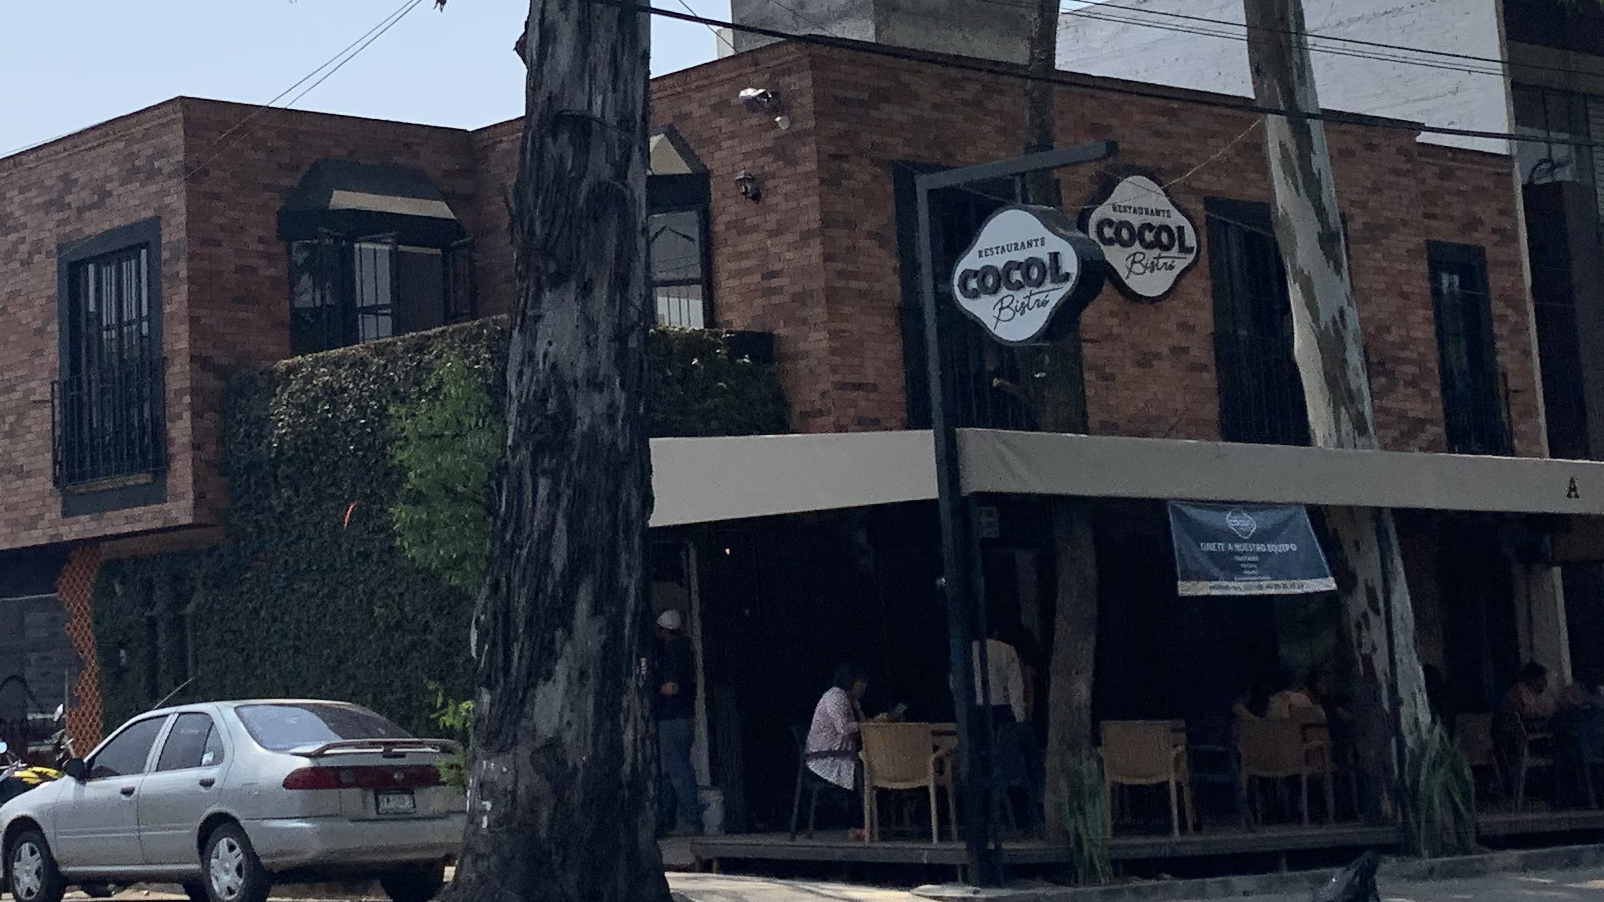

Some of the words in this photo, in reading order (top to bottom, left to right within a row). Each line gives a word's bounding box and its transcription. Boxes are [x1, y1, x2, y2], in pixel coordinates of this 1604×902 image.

[1111, 204, 1171, 218] RESTAURANTE
[978, 237, 1046, 258] RESTAURANTE
[1097, 218, 1195, 254] COCOL
[958, 251, 1071, 299] COCOL
[1567, 476, 1580, 499] A
